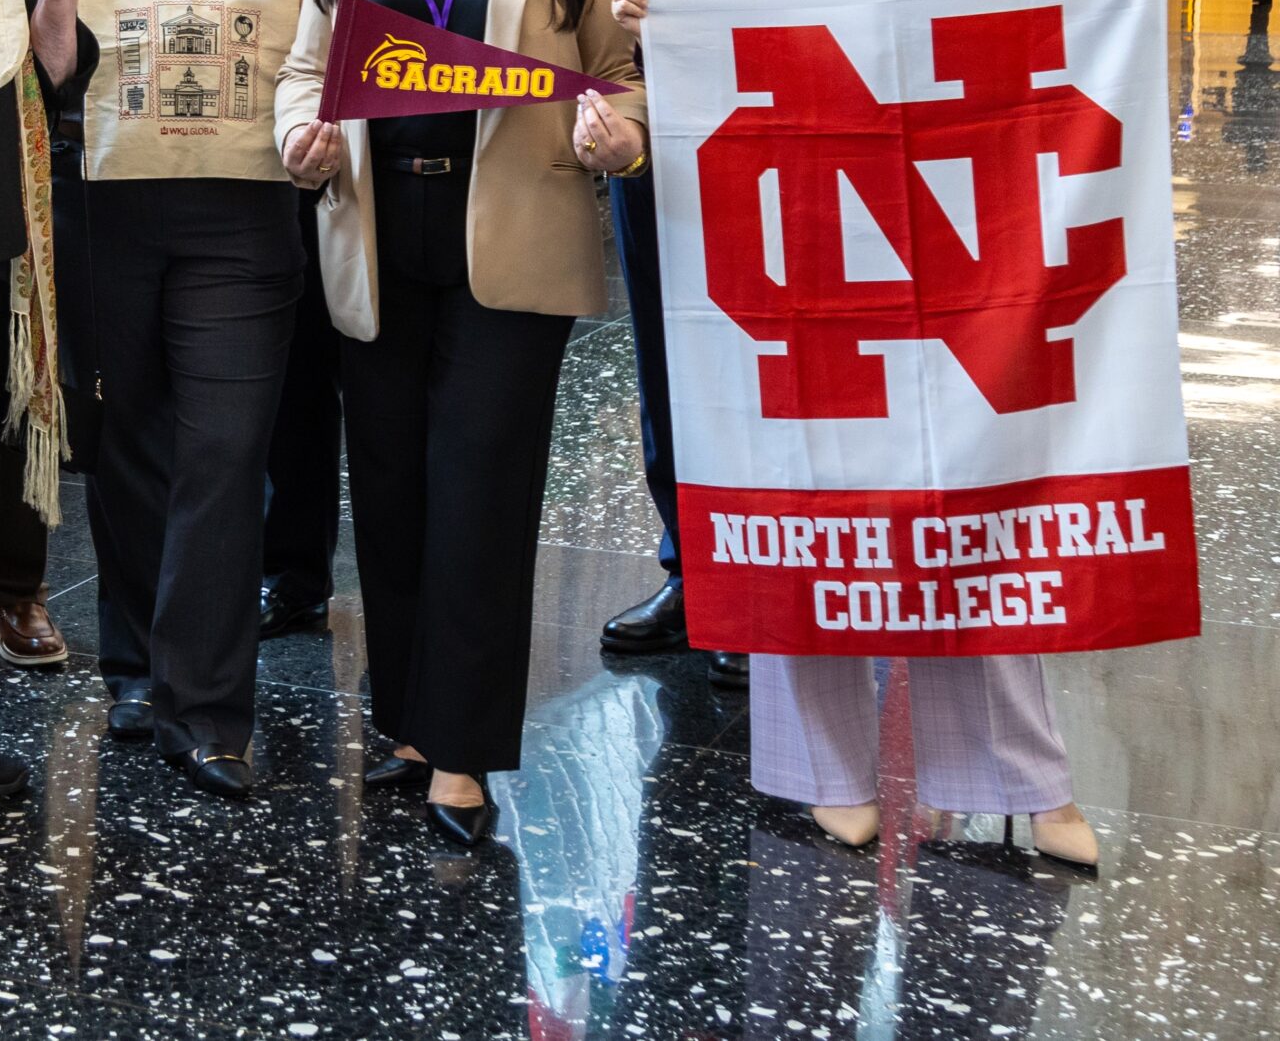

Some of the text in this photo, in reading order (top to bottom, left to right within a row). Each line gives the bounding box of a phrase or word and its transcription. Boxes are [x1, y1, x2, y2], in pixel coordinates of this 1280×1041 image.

[376, 60, 555, 98] SAGRADO
[170, 127, 219, 136] WKU GLOBAL
[710, 498, 1166, 568] NORTH CENTRAL
[814, 570, 1066, 631] COLLEGE
